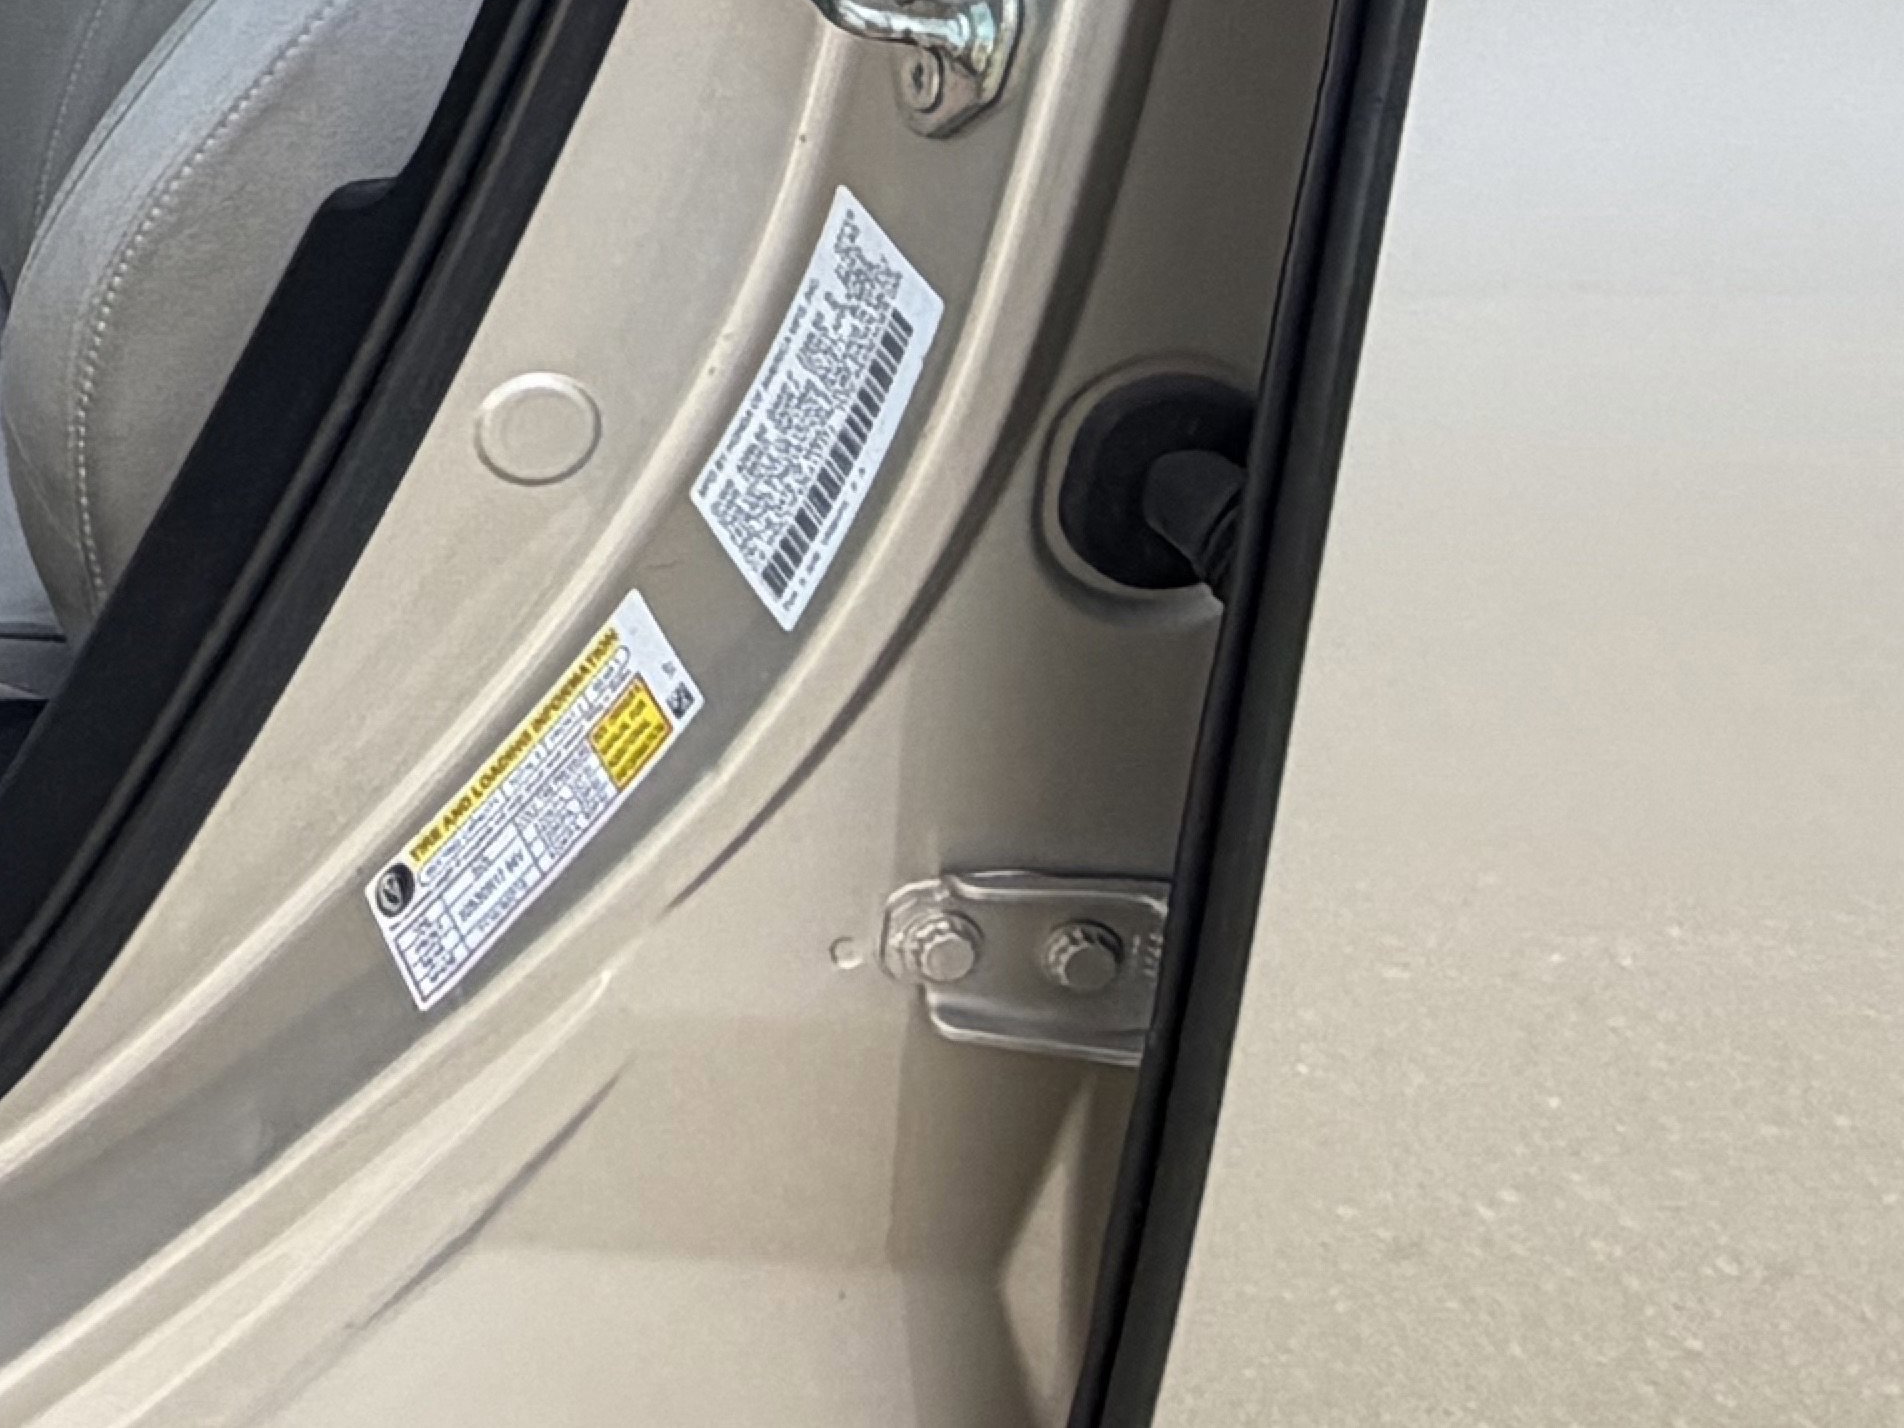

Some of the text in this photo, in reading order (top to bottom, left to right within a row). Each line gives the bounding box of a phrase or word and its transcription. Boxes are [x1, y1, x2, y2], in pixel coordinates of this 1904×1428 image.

[439, 793, 473, 832] AND
[469, 728, 532, 800] LOADING
[530, 626, 619, 733] INFORMATION
